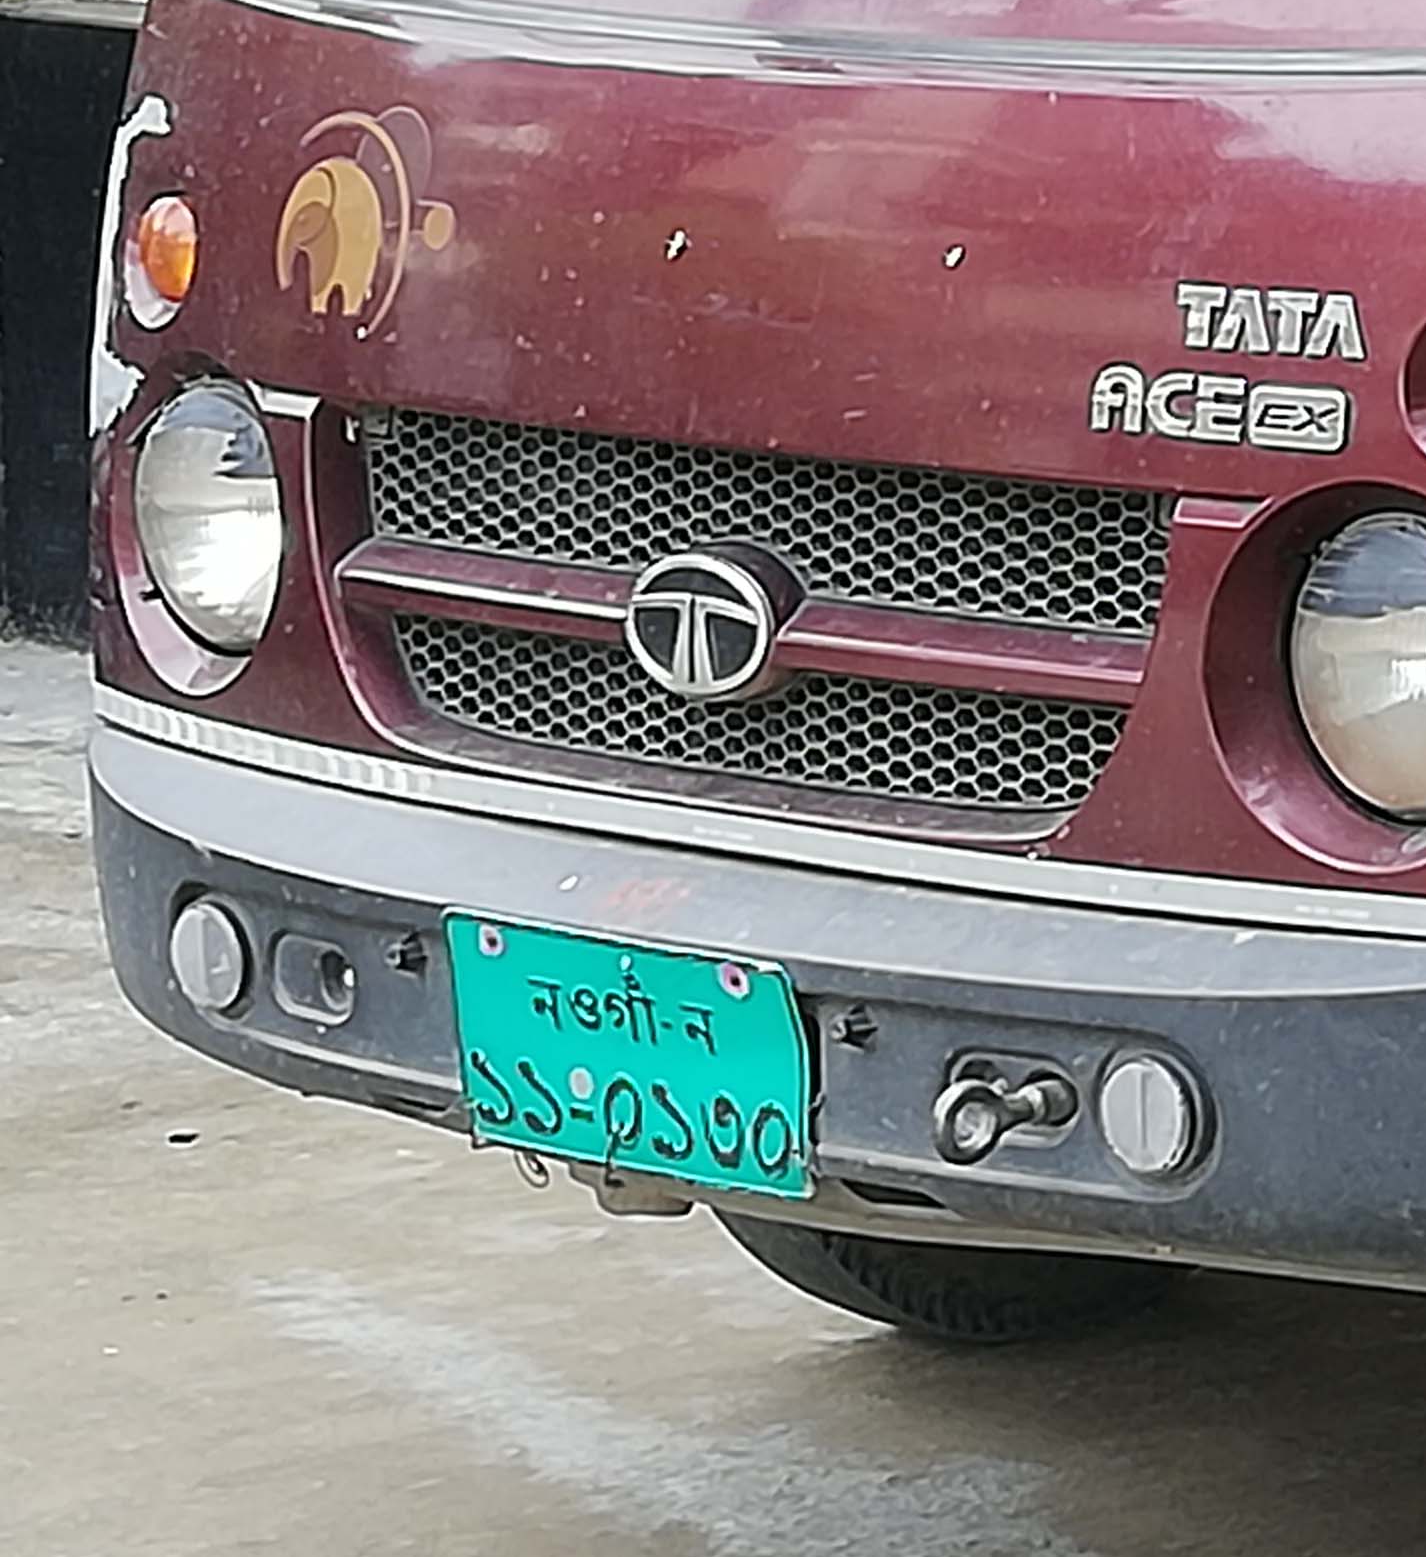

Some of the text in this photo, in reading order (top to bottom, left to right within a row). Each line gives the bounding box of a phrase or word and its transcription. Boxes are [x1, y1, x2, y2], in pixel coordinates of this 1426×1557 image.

[1176, 282, 1366, 360] TATA
[1090, 364, 1341, 443] ACE EX
